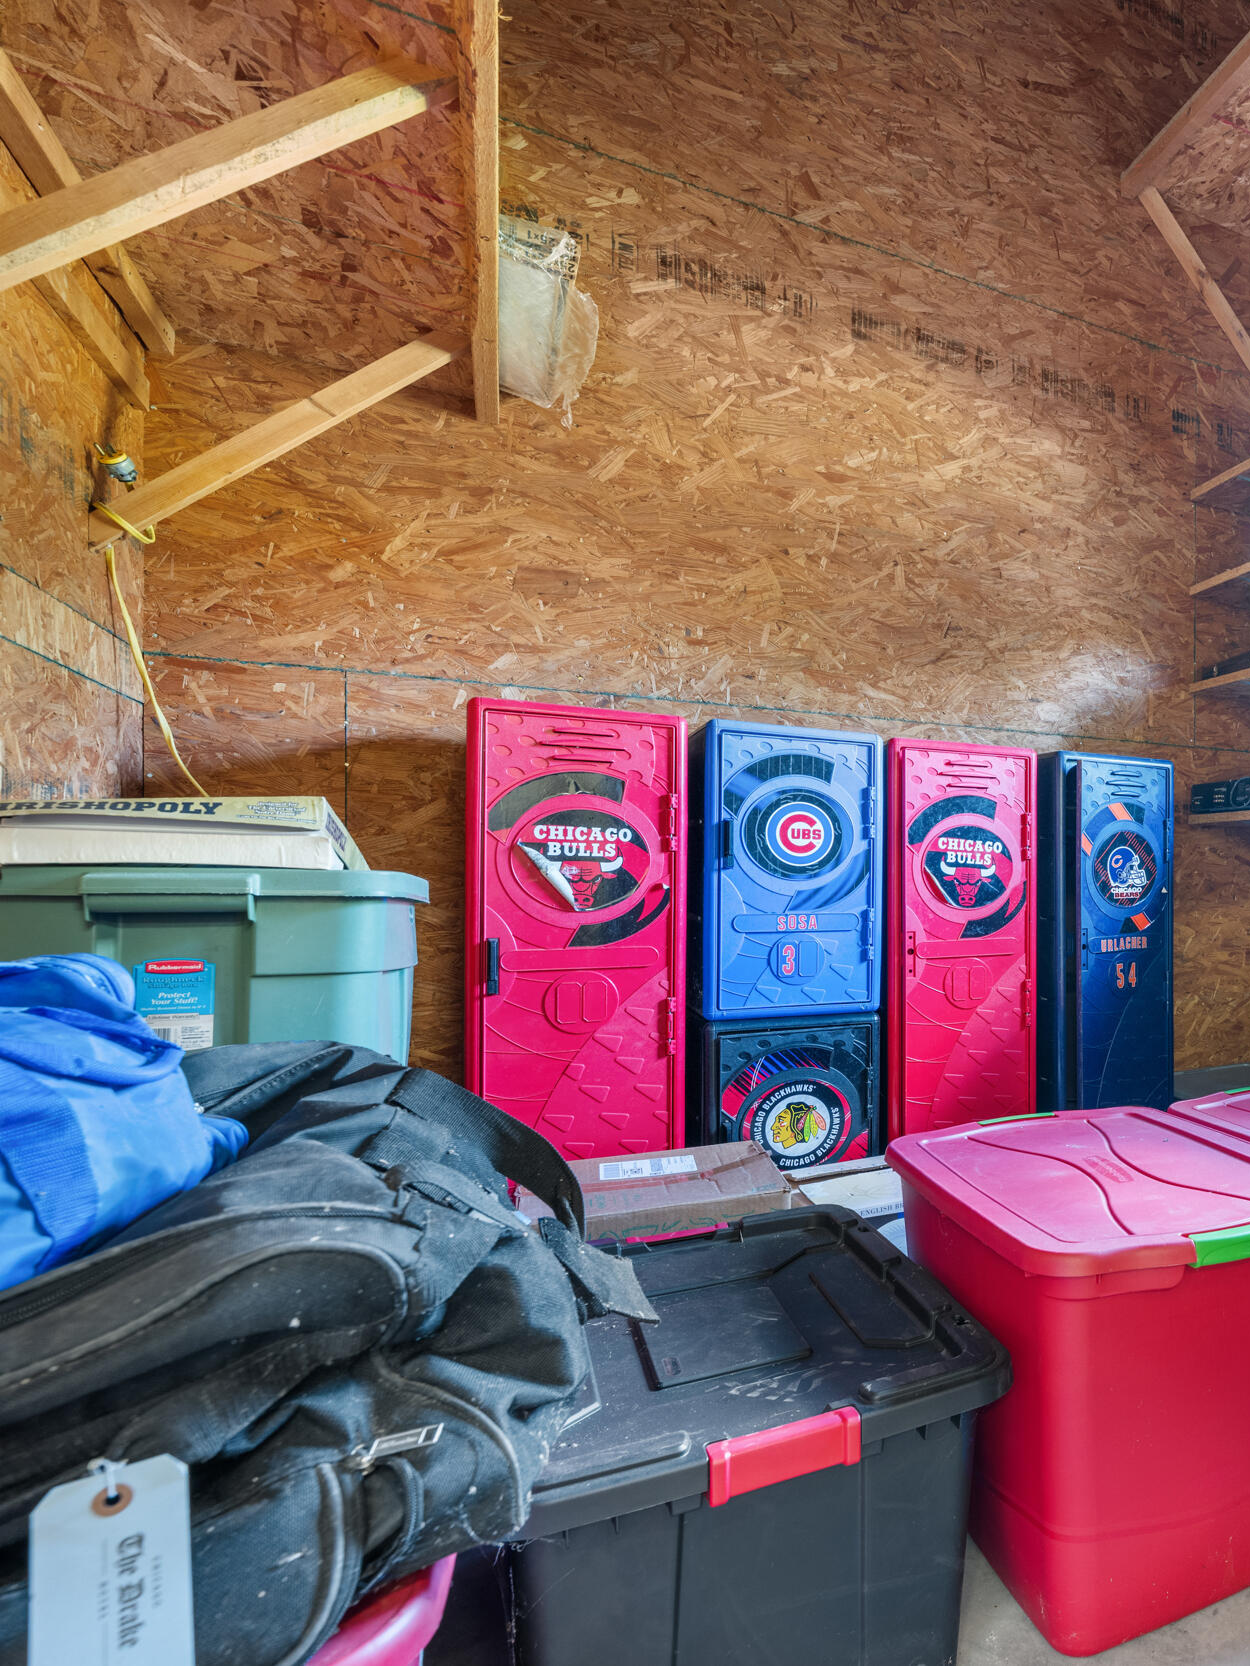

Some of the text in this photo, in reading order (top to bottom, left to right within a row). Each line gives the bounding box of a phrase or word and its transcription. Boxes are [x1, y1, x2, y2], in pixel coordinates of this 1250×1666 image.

[533, 824, 633, 842] CHICAGO
[547, 841, 617, 858] BULLS
[938, 836, 1003, 854] CHICAGO
[946, 850, 992, 867] BULLS
[1111, 886, 1142, 894] CHICAGO
[1113, 891, 1140, 899] BEARS
[777, 915, 818, 931] SOSA
[1100, 936, 1148, 953] URLACHER
[148, 963, 202, 971] Rubbermaid
[782, 944, 796, 976] 3
[158, 991, 191, 999] Protect
[763, 1084, 815, 1111] BLACKHAWKS
[779, 1107, 841, 1167] CHICAGO BLACKHAWKS
[860, 1205, 893, 1217] ENGLISH
[116, 1531, 146, 1650] The Drake
